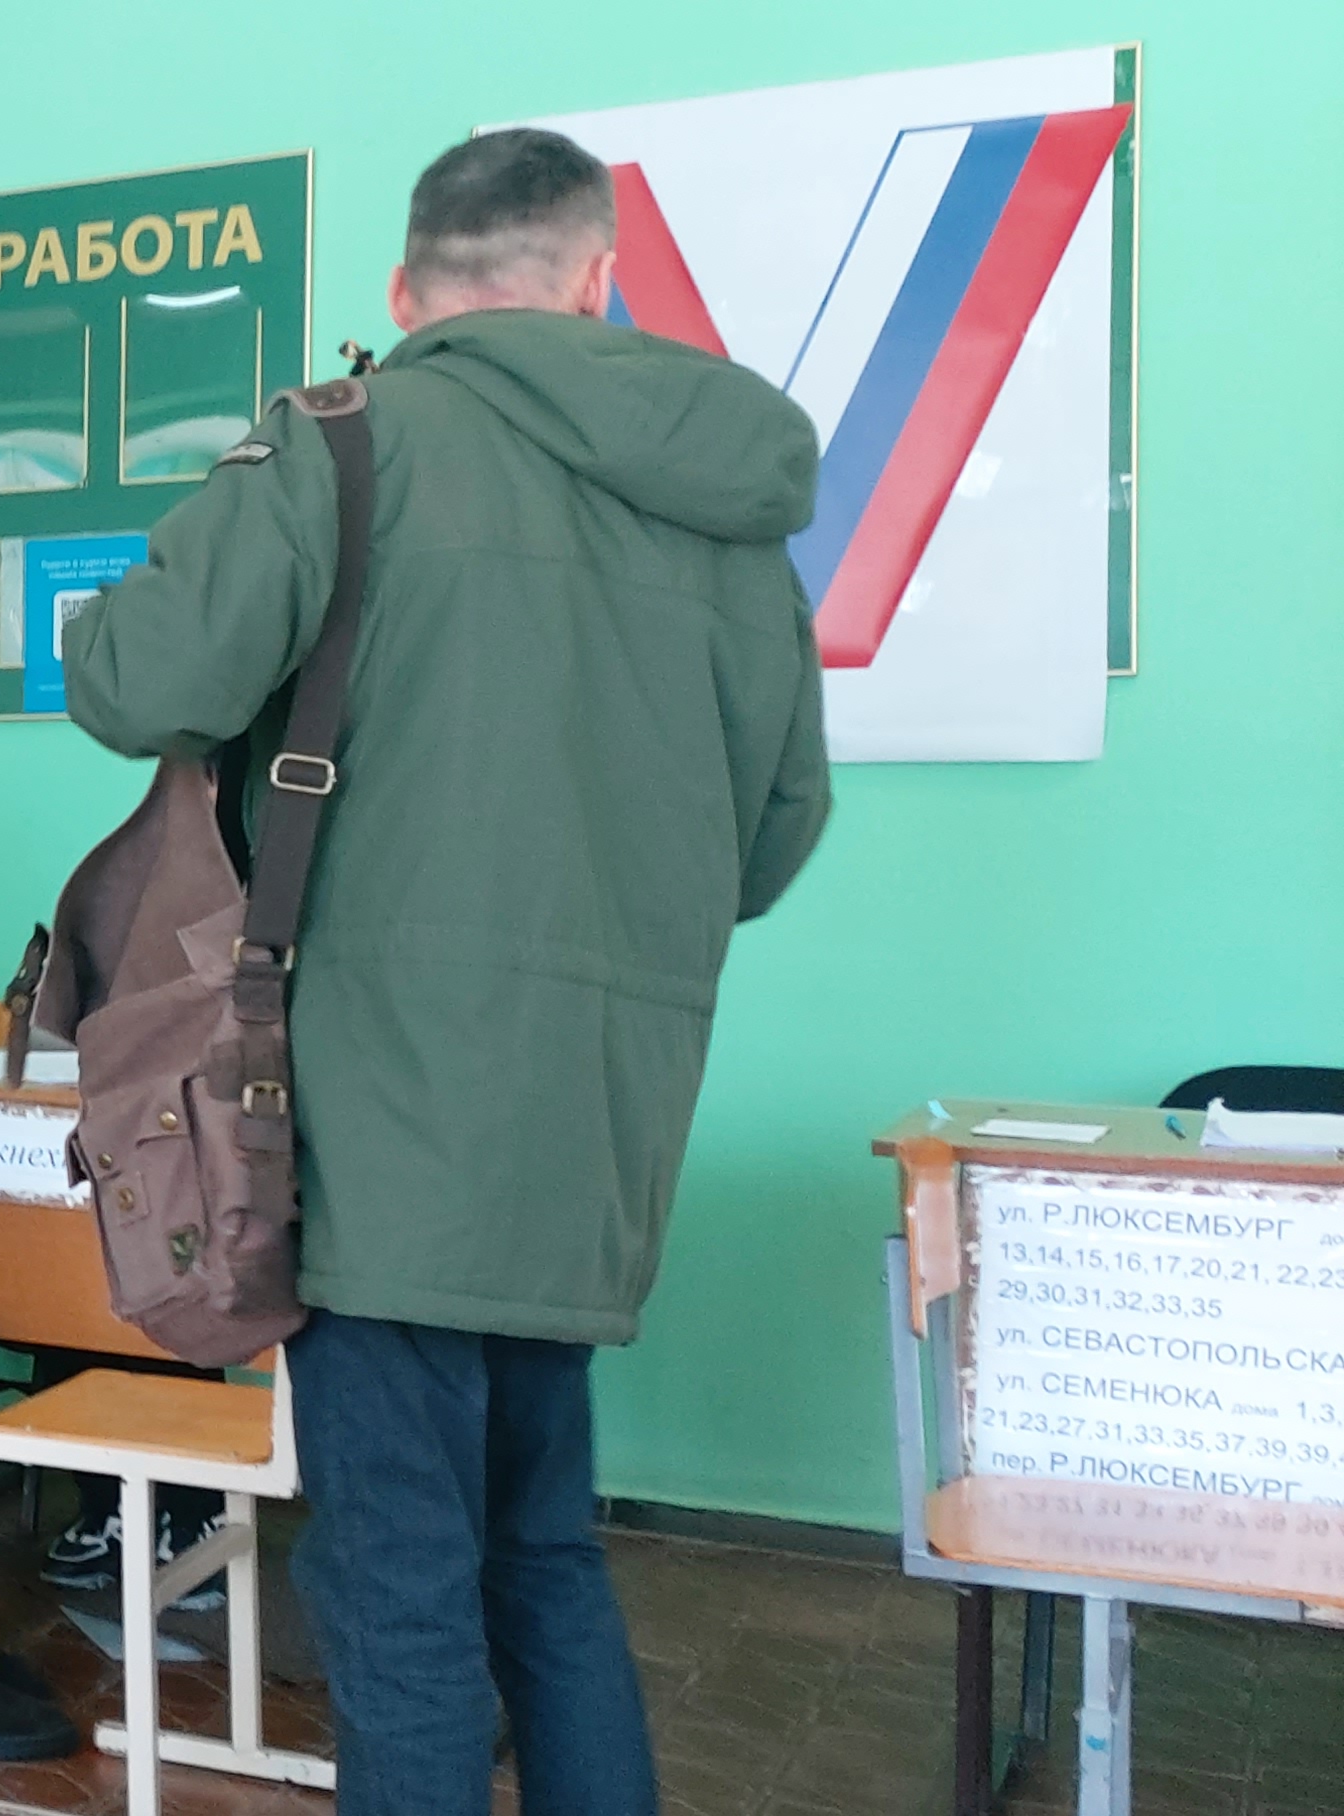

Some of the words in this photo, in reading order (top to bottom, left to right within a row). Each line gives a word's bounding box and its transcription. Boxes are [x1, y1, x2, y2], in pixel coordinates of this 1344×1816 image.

[997, 1205, 1033, 1225] ул.
[1043, 1202, 1295, 1240] Р.ЛЮКСЕМБУРГ
[997, 1327, 1032, 1347] ул.
[996, 1373, 1032, 1393] ул.
[1041, 1371, 1223, 1411] СЕМЕНЮКА
[992, 1451, 1042, 1475] пер.
[1050, 1451, 1304, 1503] Р.ЛЮКСЕМБУРГ
